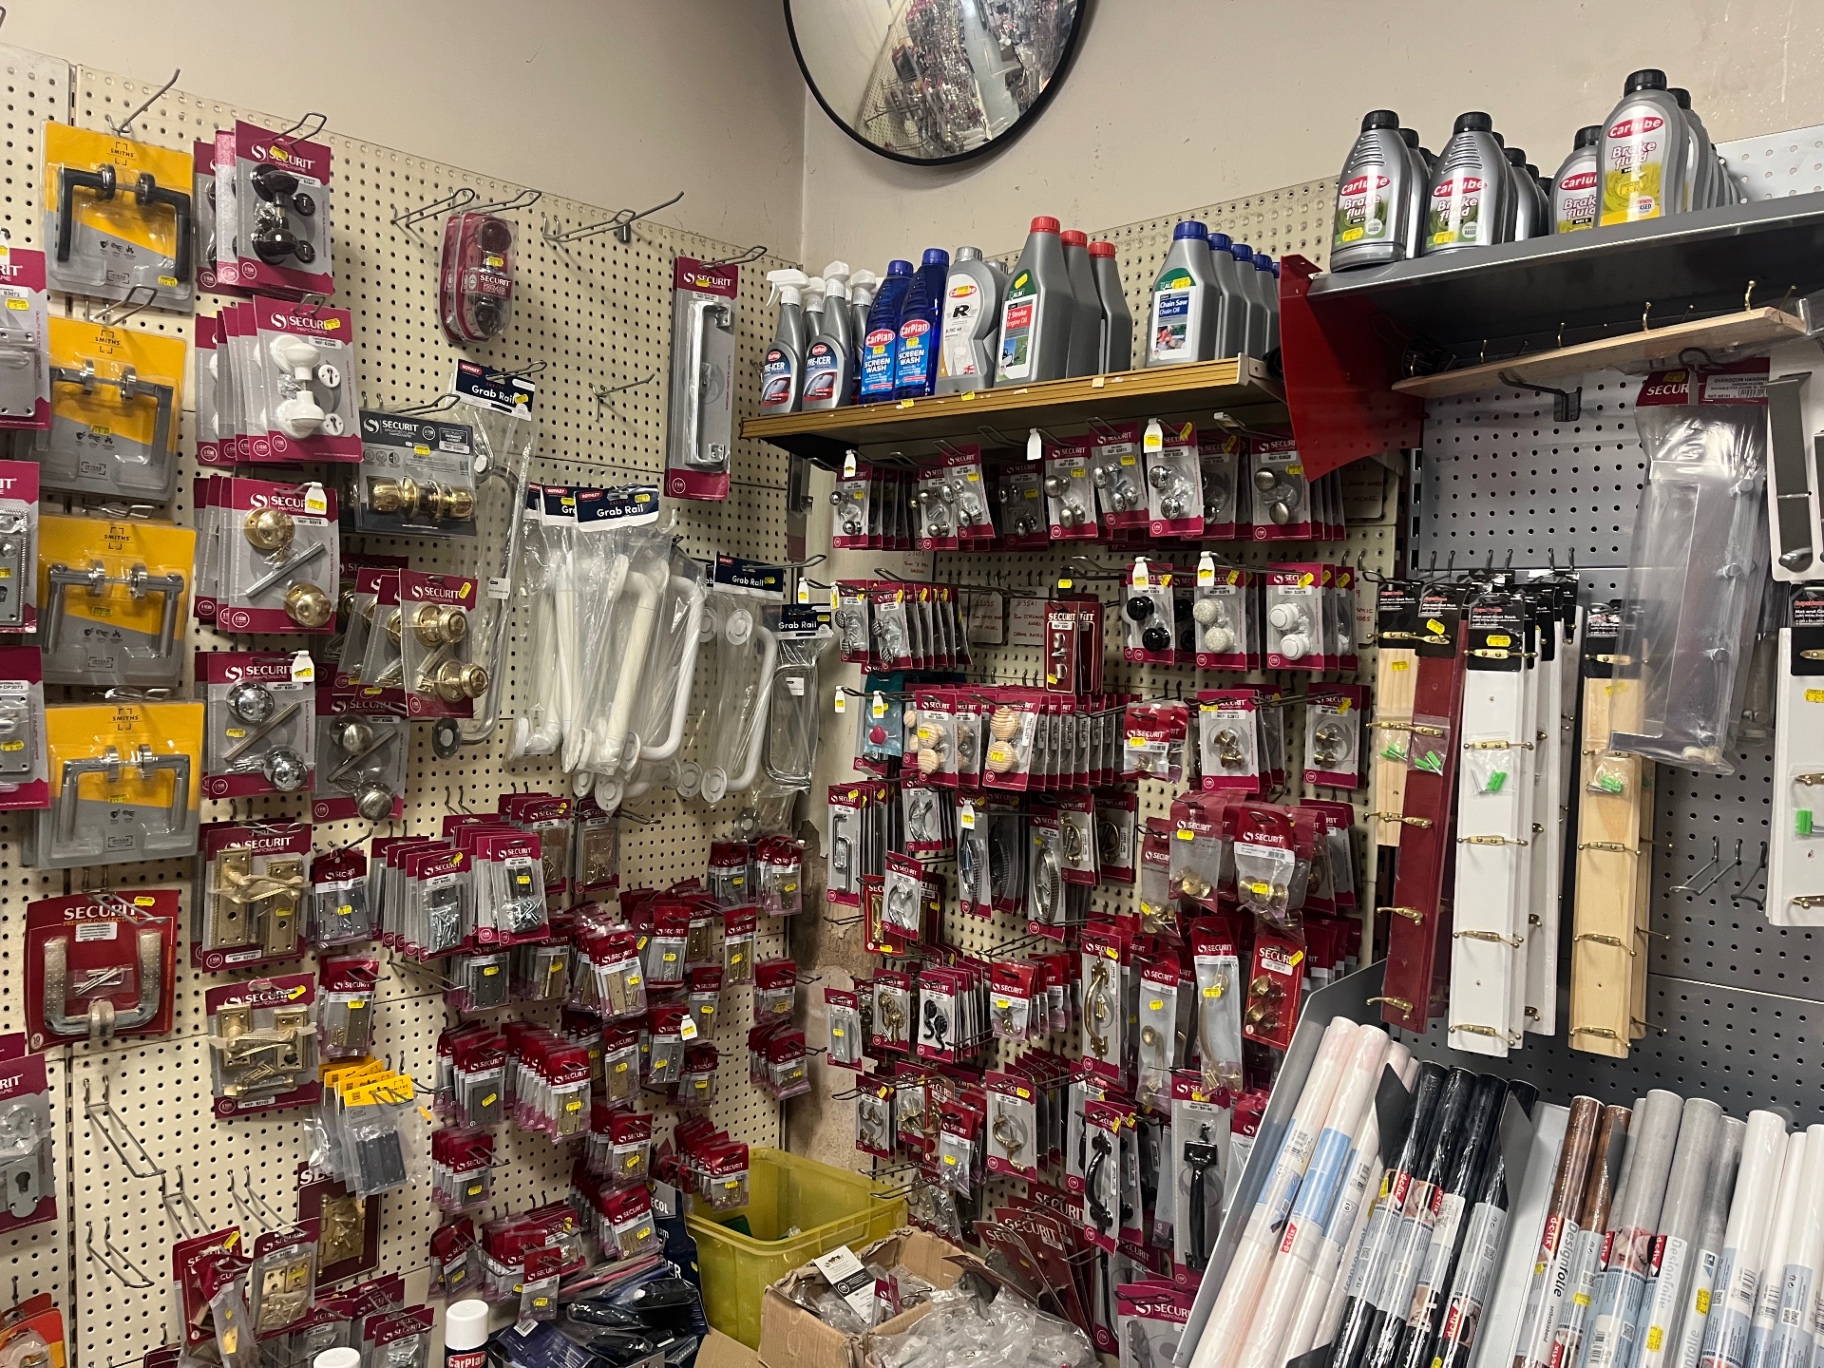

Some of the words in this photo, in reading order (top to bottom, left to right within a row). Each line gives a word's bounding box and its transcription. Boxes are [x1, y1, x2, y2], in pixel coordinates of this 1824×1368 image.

[1610, 119, 1661, 137] Carlube
[110, 149, 134, 158] SMITHS
[1612, 141, 1657, 159] Brake
[1615, 153, 1648, 171] fluid
[1341, 177, 1388, 195] Carlube
[1562, 173, 1597, 189] Carlu
[1434, 179, 1487, 196] Carlube
[1344, 194, 1381, 210] Brake
[1437, 197, 1477, 212] Brake
[1563, 195, 1596, 210] Brak
[1346, 205, 1372, 220] fluid
[480, 275, 512, 287] SECURIT
[1012, 310, 1027, 318] Stroke
[289, 316, 326, 329] SECUR
[1007, 320, 1020, 328] Engine
[901, 324, 928, 335] CarPlan
[95, 336, 121, 346] SMITHS
[867, 333, 893, 343] CarPlan
[899, 350, 925, 359] SCREEN
[865, 358, 890, 368] SCREEN
[901, 357, 920, 365] WASH
[866, 365, 886, 373] WASH
[472, 385, 497, 398] Grab
[499, 392, 515, 404] Rail
[1647, 384, 1689, 396] SECUR
[382, 420, 419, 432] SECURIT
[1062, 447, 1086, 455] SECURIT
[597, 505, 621, 518] Grab
[624, 503, 644, 515] Rail
[732, 575, 749, 585] Grab
[750, 577, 764, 587] Rail
[424, 587, 459, 598] SECURIT
[1048, 612, 1076, 621] SECURIT
[779, 620, 799, 630] Grab
[801, 620, 817, 630] Rail
[1136, 730, 1164, 738] SECURIT
[1187, 821, 1212, 831] SECURIT
[245, 837, 290, 849] SECURIT
[1255, 833, 1284, 844] SECURIT
[508, 847, 532, 856] SECURIT
[64, 905, 137, 920] SECURIT
[1207, 944, 1232, 953] SECURIT
[1259, 947, 1290, 965] SECUR
[1001, 984, 1024, 994] SECURIT
[723, 1163, 743, 1173] SECURIT
[623, 1203, 644, 1217] SECURIT
[1005, 1218, 1057, 1240] SECURIT
[1554, 1222, 1579, 1298] Designfolie
[1660, 1239, 1682, 1309] Designfolie
[1152, 1303, 1191, 1321] SECUR
[1684, 1330, 1699, 1368] nfolie
